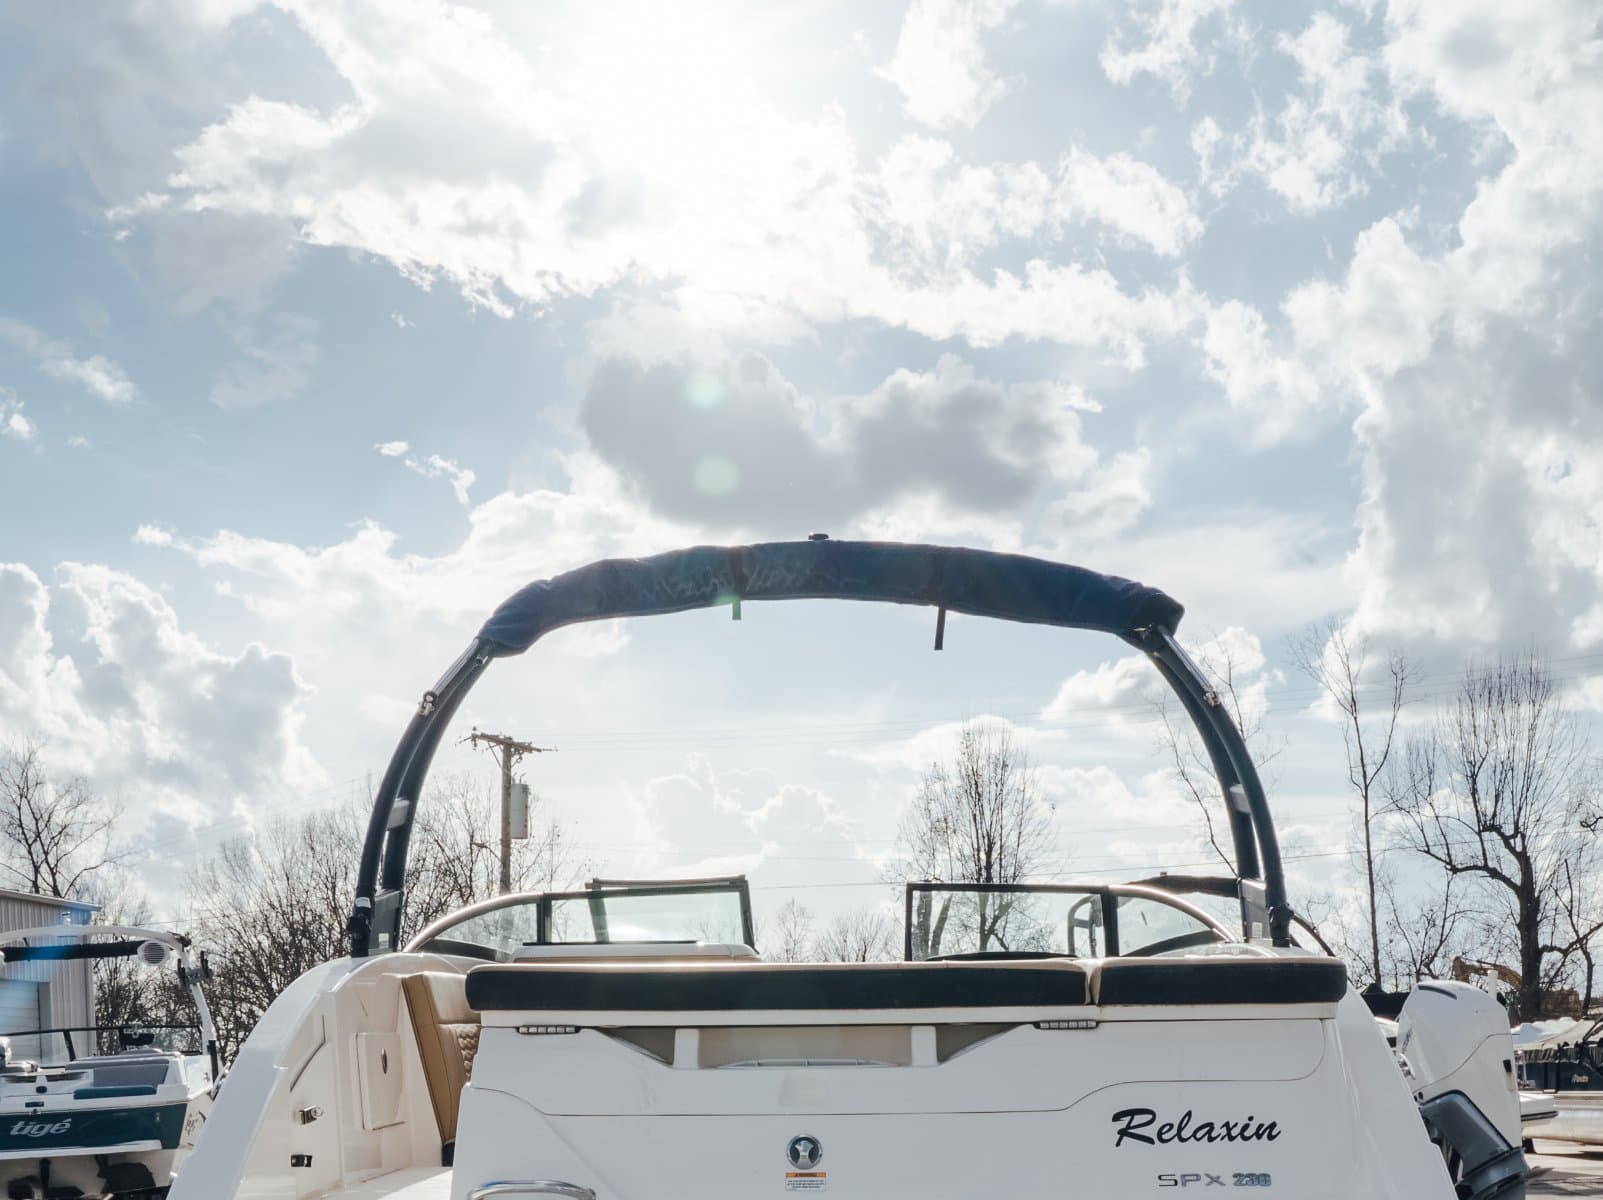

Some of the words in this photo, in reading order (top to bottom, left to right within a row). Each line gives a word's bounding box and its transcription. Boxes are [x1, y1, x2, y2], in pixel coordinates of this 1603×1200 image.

[9, 1118, 72, 1137] tigé
[1112, 1108, 1281, 1147] Relaxin
[1158, 1173, 1226, 1187] SPX
[1232, 1173, 1271, 1187] 230
